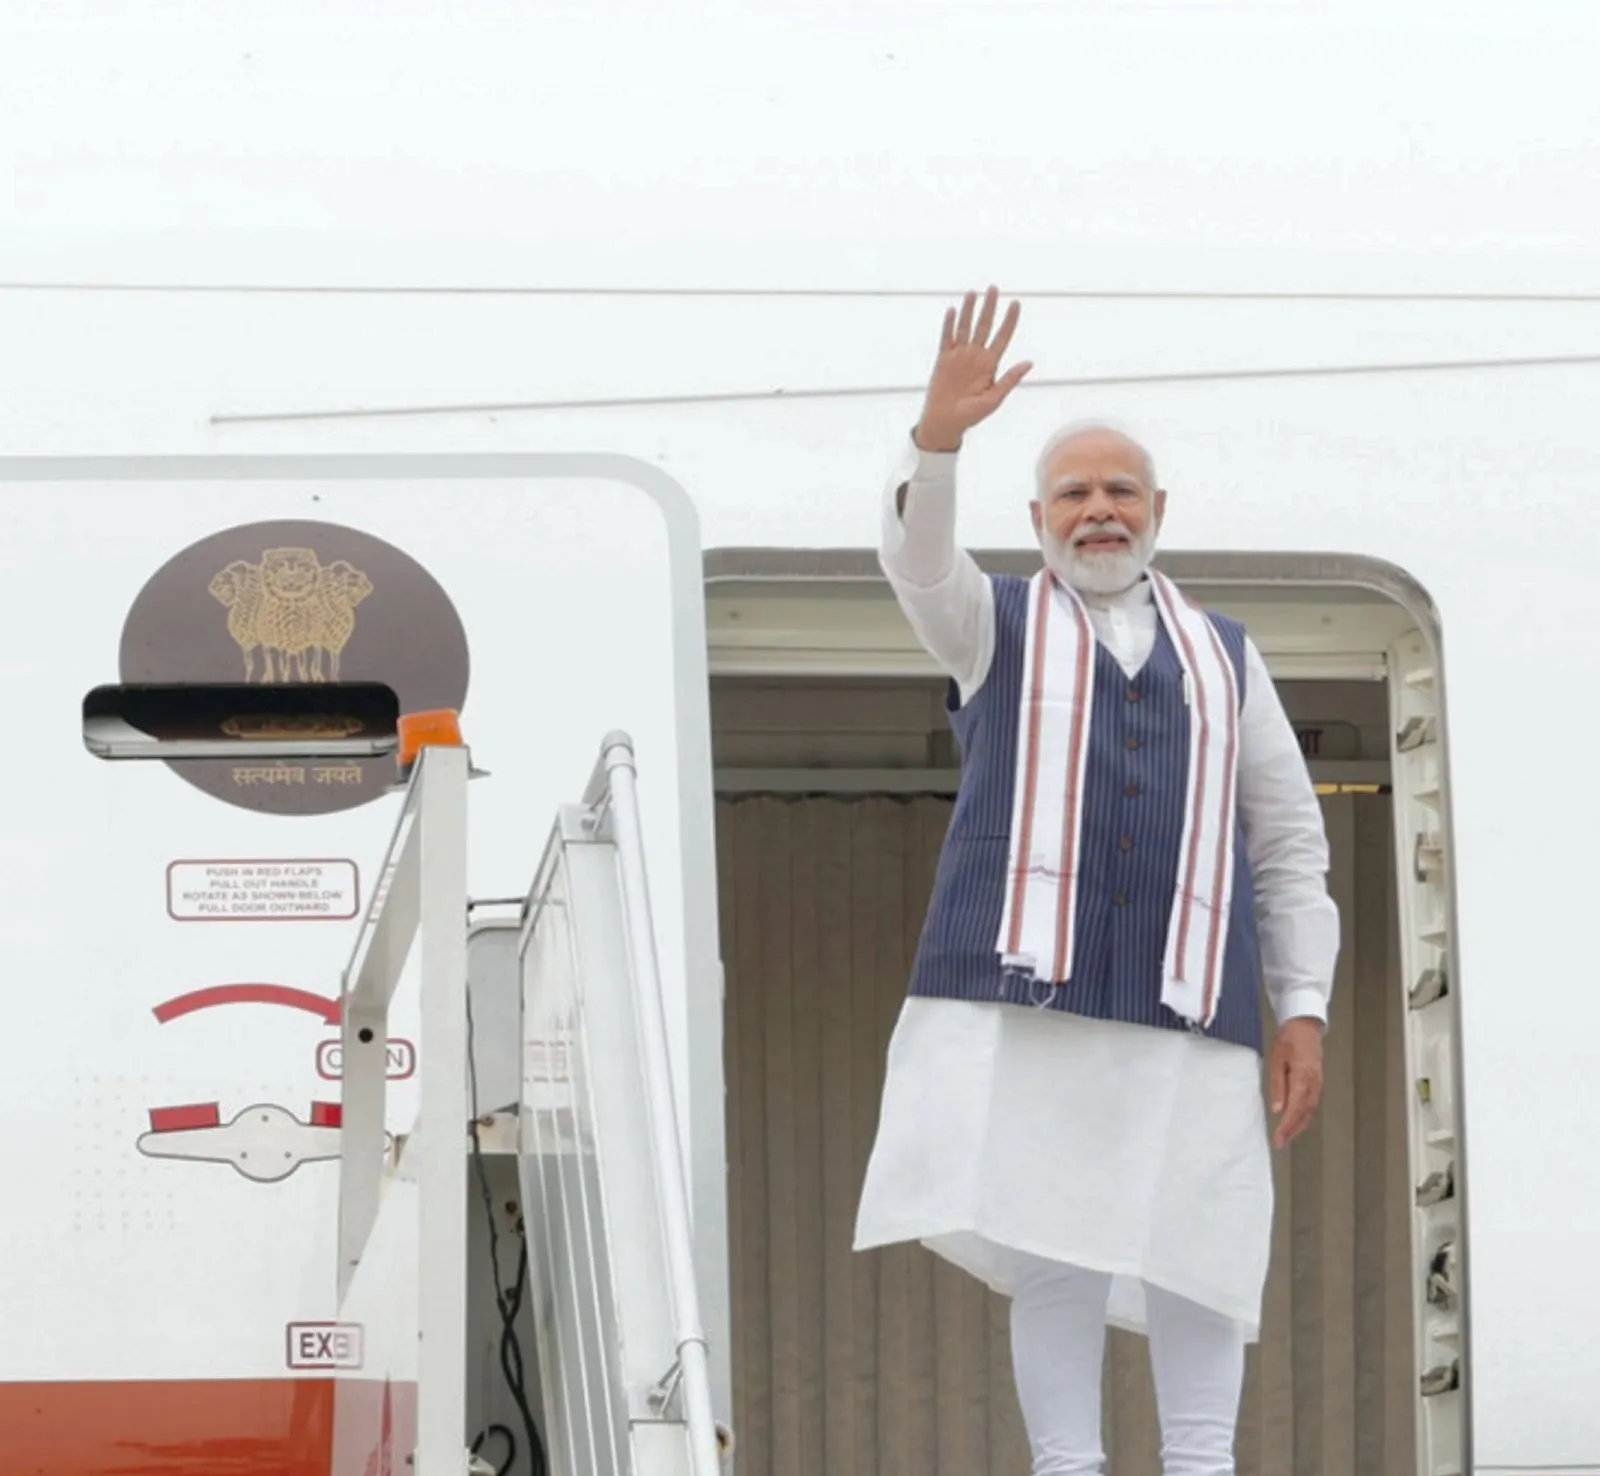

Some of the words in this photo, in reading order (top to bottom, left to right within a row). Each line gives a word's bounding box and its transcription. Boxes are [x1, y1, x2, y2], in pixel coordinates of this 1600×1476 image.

[232, 760, 306, 787] सत्यमेव
[312, 760, 363, 785] जयते
[206, 867, 238, 877] PUSH
[241, 867, 254, 877] IN
[257, 867, 282, 877] RED
[284, 866, 323, 877] FLAPS
[210, 879, 240, 889] PULL
[243, 879, 267, 889] OUT
[270, 878, 319, 888] HANDLE
[182, 891, 228, 901] ROTATE
[232, 891, 248, 901] AS
[252, 891, 296, 901] SHOWN
[298, 890, 342, 900] BELOW
[198, 903, 228, 913] PULL
[232, 902, 267, 913] DOOR
[269, 902, 330, 912] OUTWARD
[326, 1048, 403, 1069] ON
